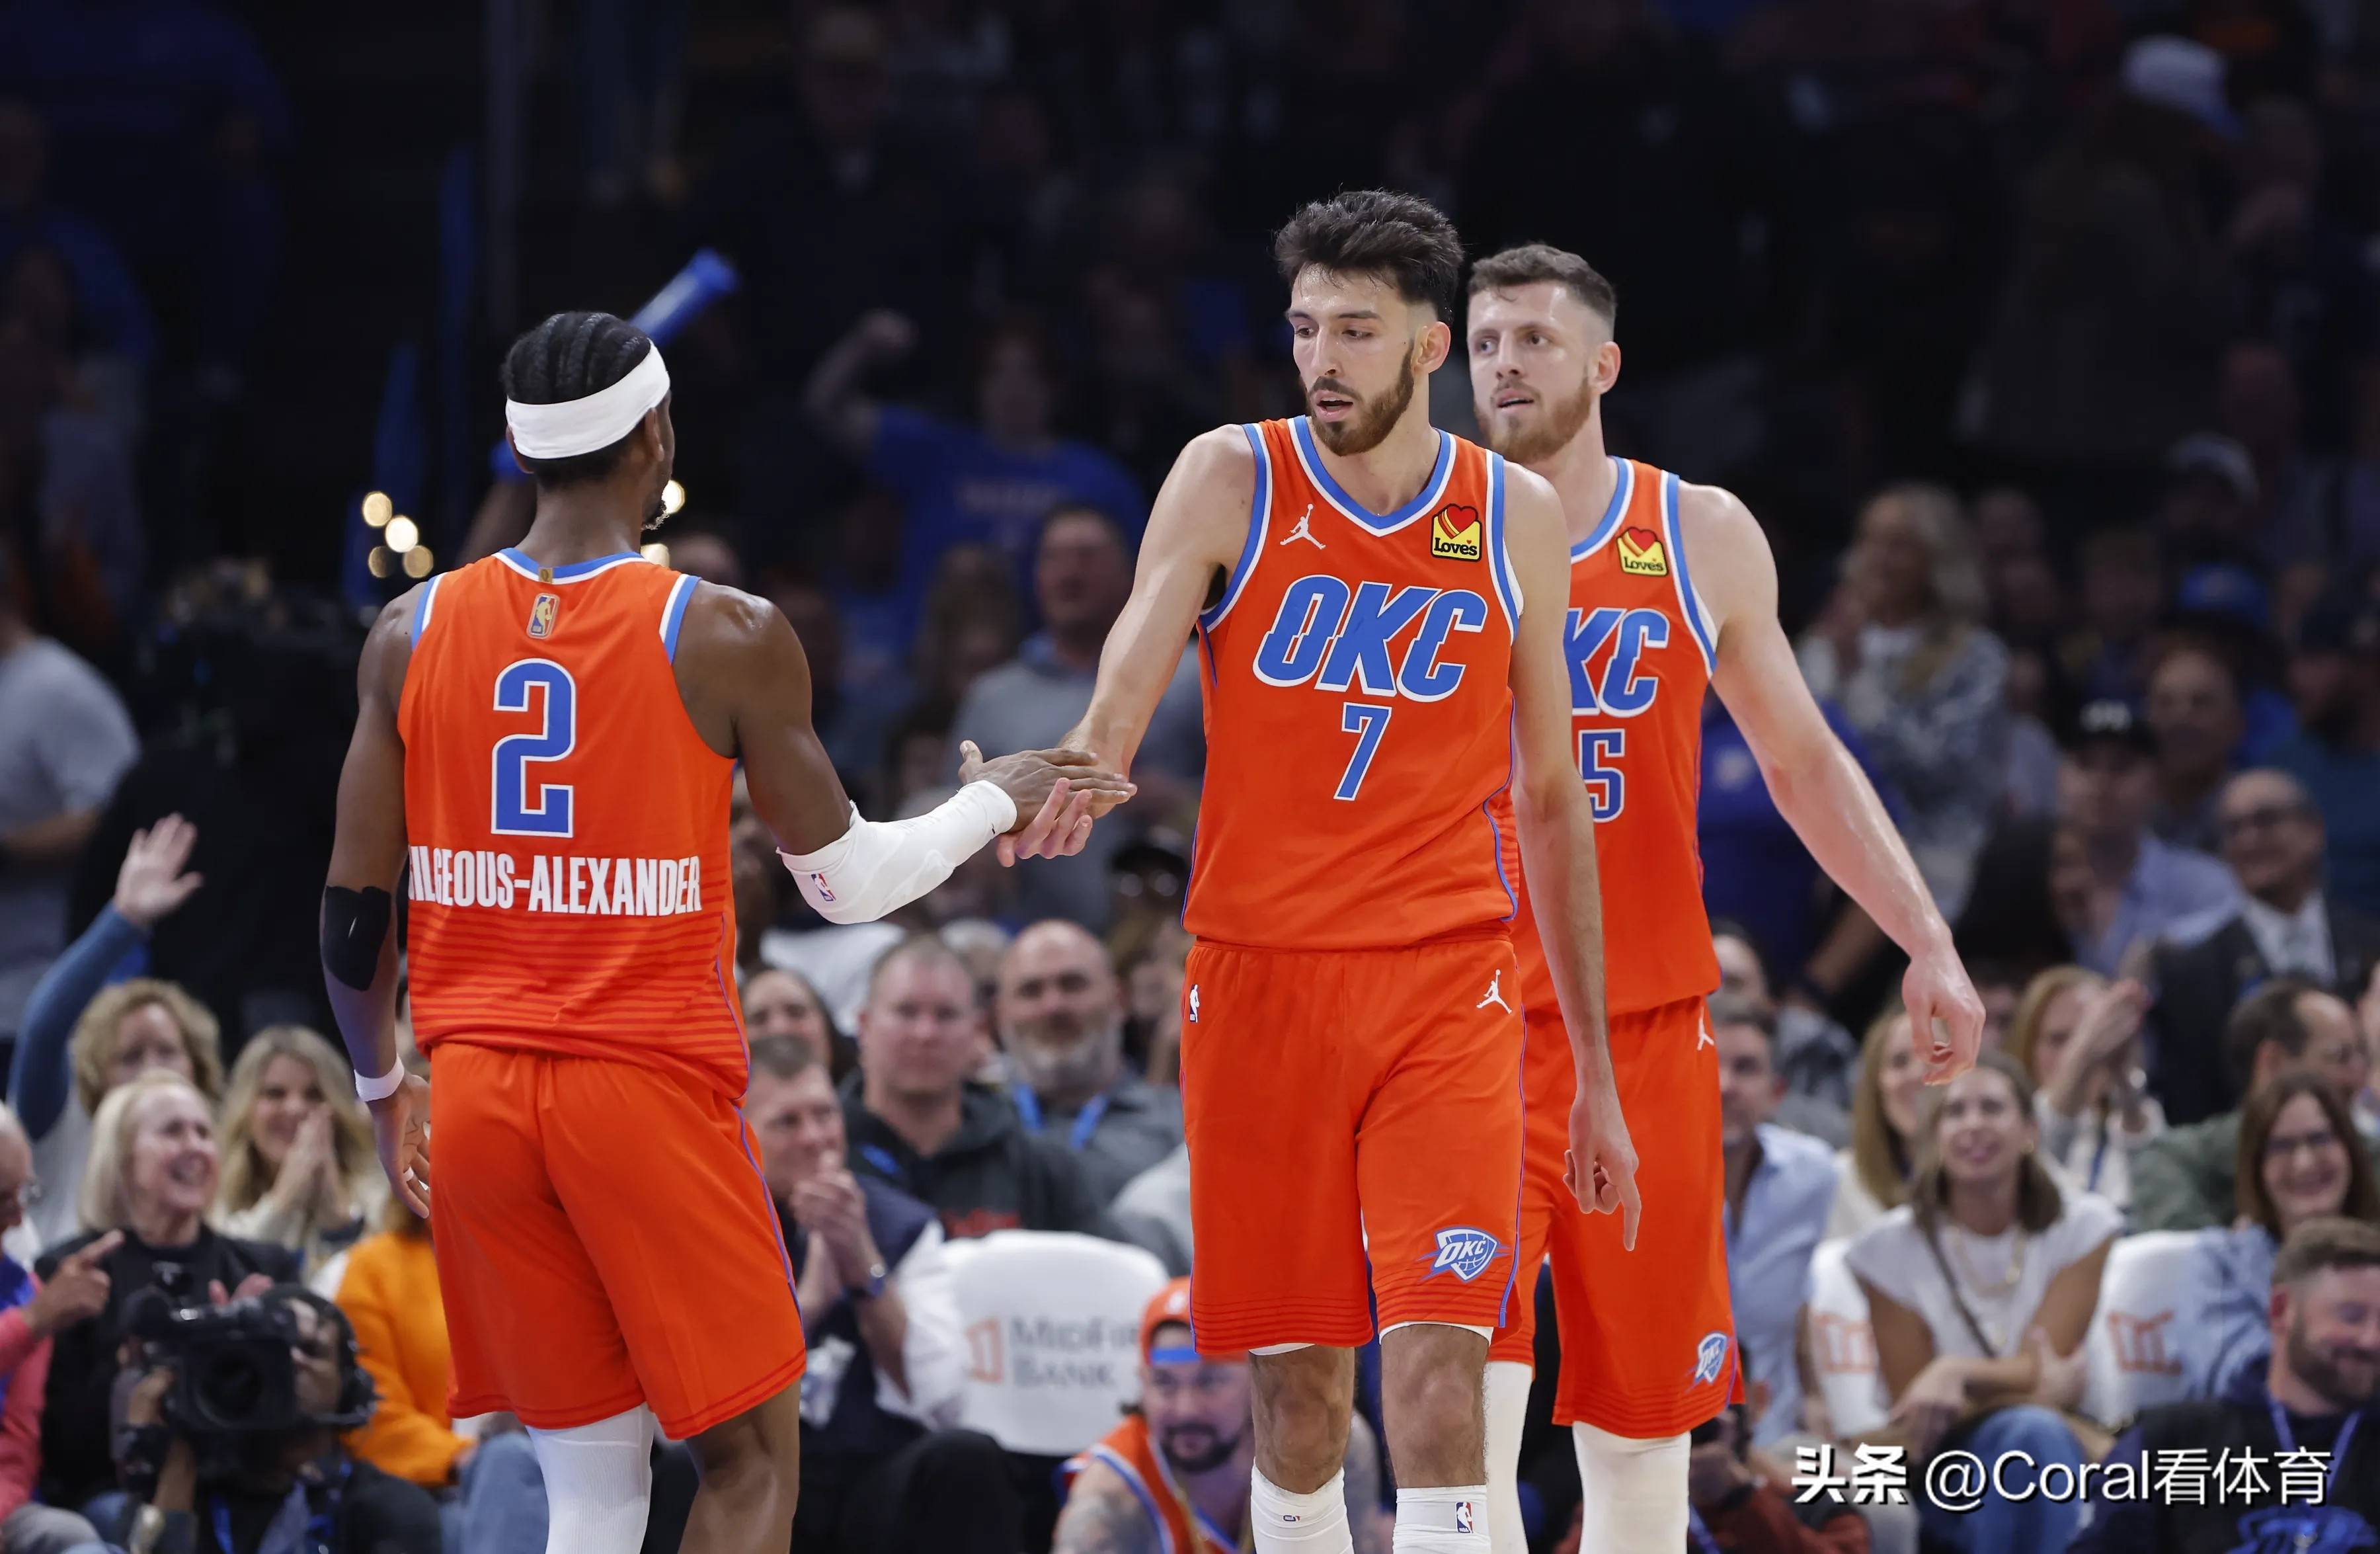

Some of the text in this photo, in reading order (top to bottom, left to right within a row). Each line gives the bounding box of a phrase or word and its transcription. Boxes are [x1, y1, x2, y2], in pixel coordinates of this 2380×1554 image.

[1253, 574, 1488, 702] OKC
[1563, 607, 1670, 717] KC
[491, 658, 576, 838] 2
[1333, 702, 1392, 801] 7
[1434, 1239, 1487, 1268] OKC
